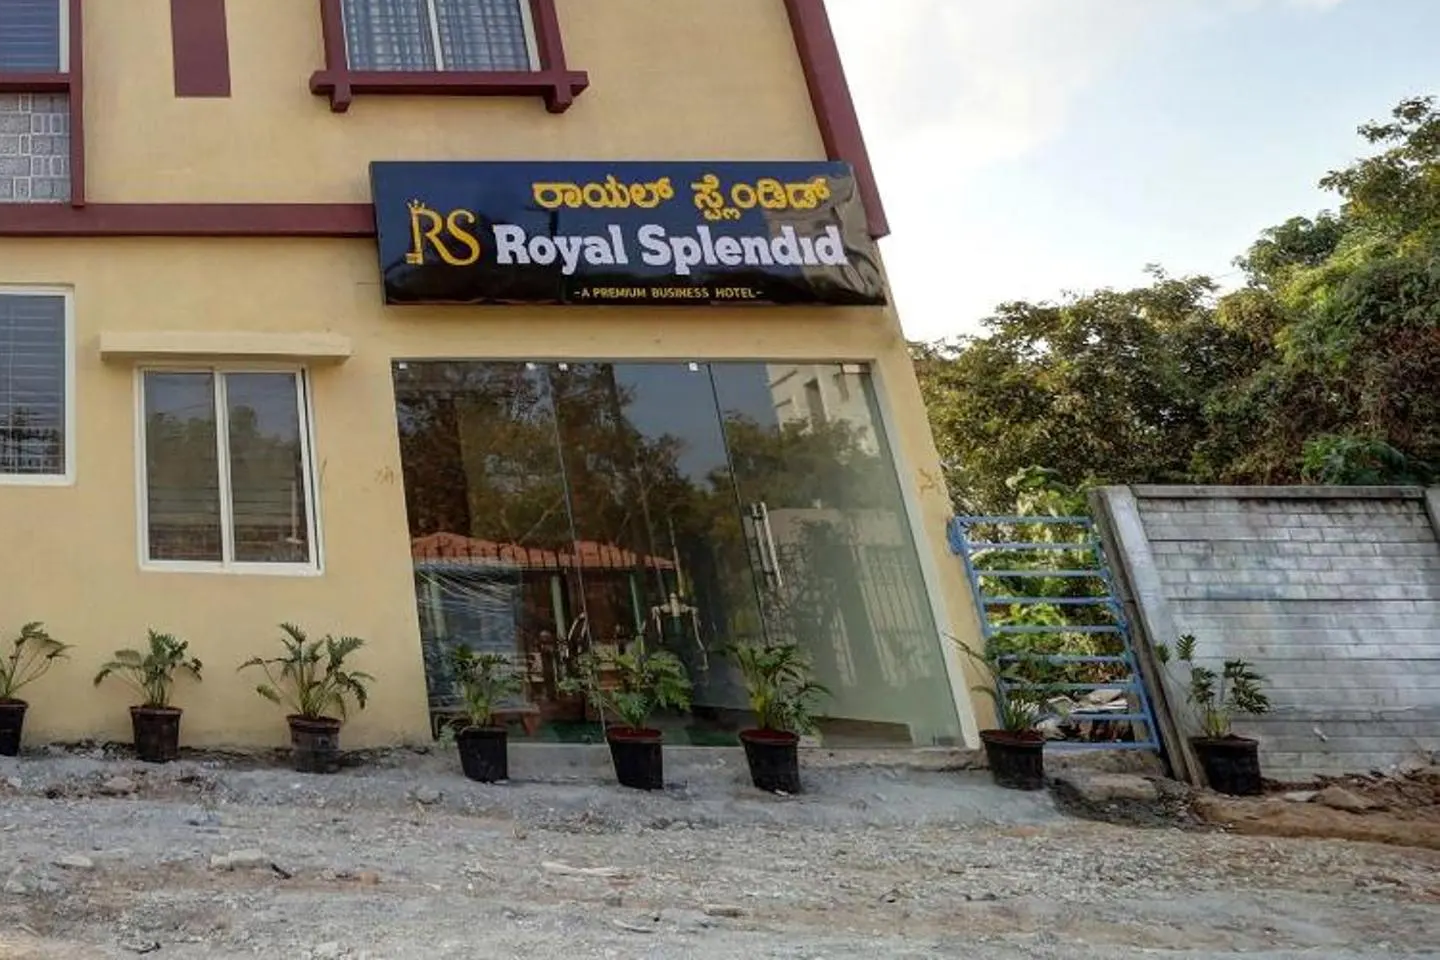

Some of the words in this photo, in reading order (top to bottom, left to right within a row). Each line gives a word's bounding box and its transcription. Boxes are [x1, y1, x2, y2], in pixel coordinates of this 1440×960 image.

[407, 200, 480, 266] RS
[493, 224, 629, 275] Royal
[637, 224, 848, 275] Splendid
[592, 287, 647, 298] PREMIUM
[651, 287, 709, 298] BUSINESS
